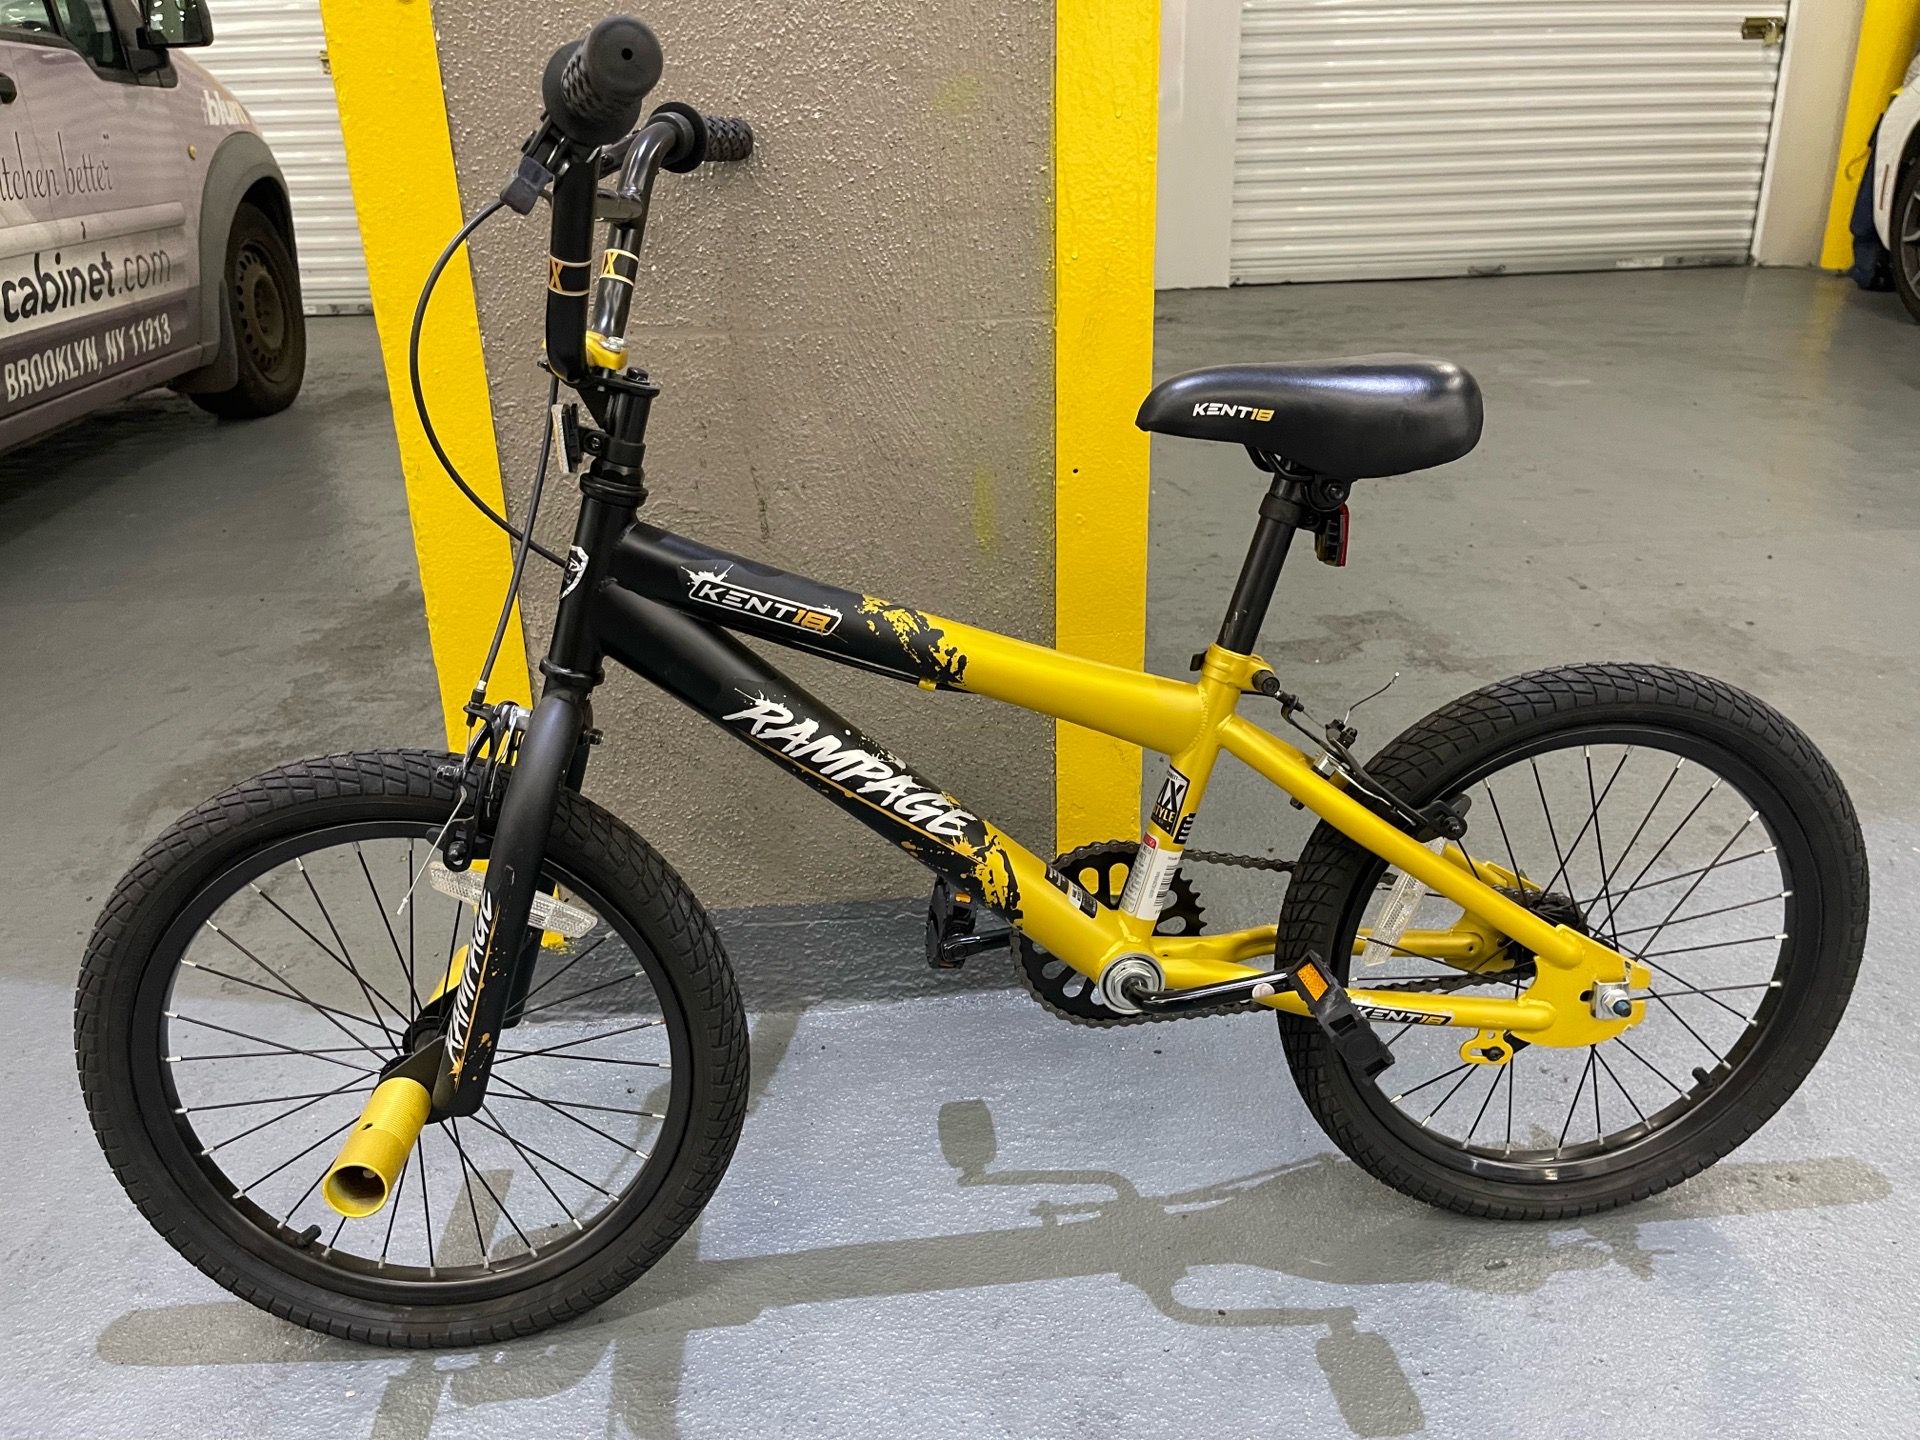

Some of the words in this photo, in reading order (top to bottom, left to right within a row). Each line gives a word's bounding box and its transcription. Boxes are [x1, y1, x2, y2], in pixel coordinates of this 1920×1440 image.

[0, 131, 59, 201] itchen
[2, 250, 171, 322] cabinet.com
[5, 336, 103, 402] BROOKLYN,
[105, 327, 126, 366] NY
[129, 313, 171, 356] 11213
[722, 698, 978, 836] RAMPAGE
